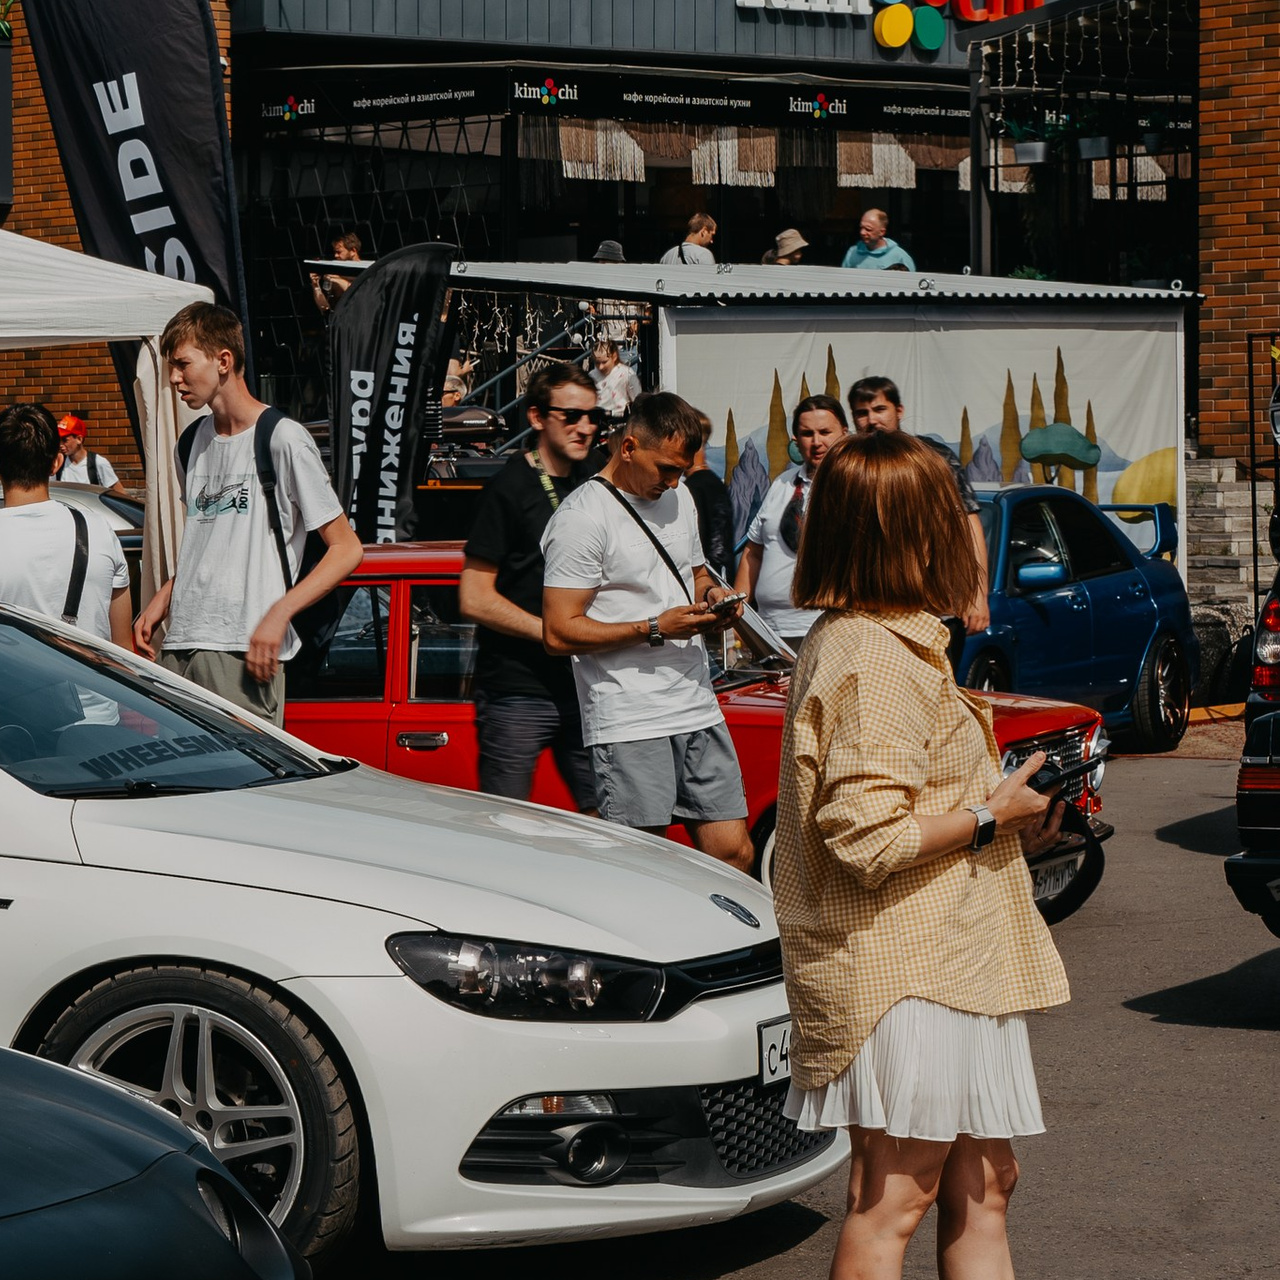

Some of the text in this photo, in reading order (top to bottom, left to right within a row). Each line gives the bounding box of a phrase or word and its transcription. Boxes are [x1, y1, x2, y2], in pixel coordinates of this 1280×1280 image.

[352, 97, 372, 109] кафе
[372, 92, 410, 108] корейской
[416, 88, 453, 102] азиатской
[453, 88, 475, 102] кухни
[513, 81, 579, 101] kim chi
[623, 91, 644, 104] кафе
[644, 92, 684, 106] корейской
[691, 95, 728, 108] азиатской
[729, 98, 751, 110] кухни
[788, 96, 848, 115] kim chi
[882, 103, 903, 116] кафе
[903, 105, 940, 117] корейской
[947, 109, 971, 118] азиатс
